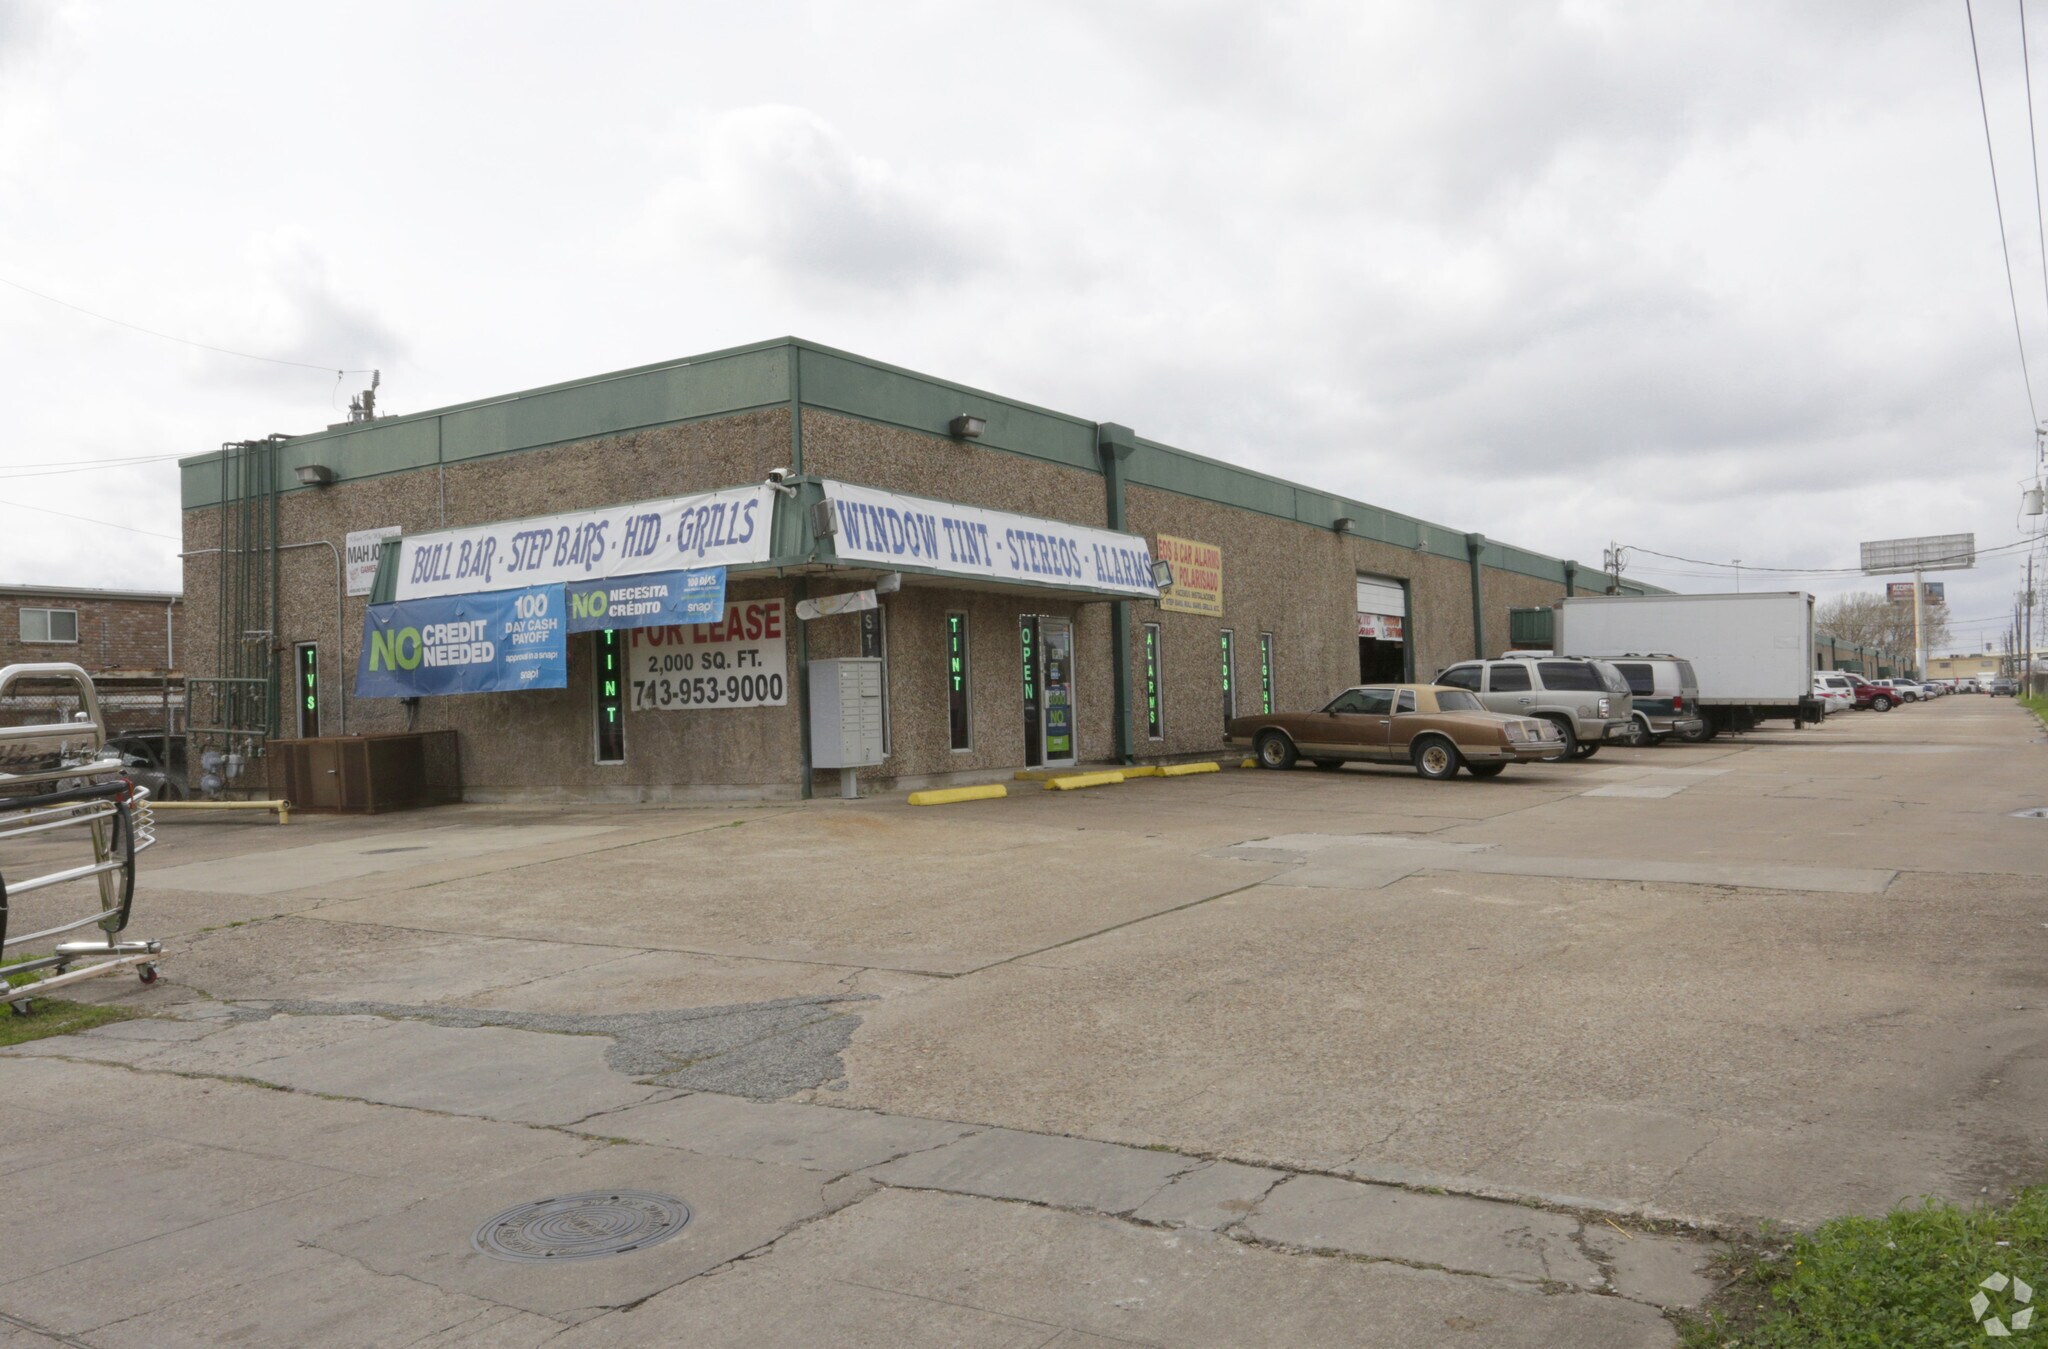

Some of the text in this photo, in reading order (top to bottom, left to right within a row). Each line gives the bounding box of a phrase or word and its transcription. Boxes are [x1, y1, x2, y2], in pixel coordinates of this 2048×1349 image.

[348, 543, 382, 564] MAH JO
[411, 498, 758, 584] BULL BAR STEP BARS HID GRILLS
[836, 500, 1155, 589] WINDOW TINT STEREOS ALARMS
[1180, 543, 1192, 565] CAR
[1194, 545, 1220, 570] ALARMS
[514, 593, 548, 619] 100
[572, 585, 669, 619] NO NECESITA
[608, 601, 661, 617] CRÉDITO
[505, 618, 557, 634] DAY CASH
[512, 630, 550, 645] PAYOFF
[632, 603, 782, 648] FOR LEASE
[1358, 615, 1371, 626] UTO
[1358, 626, 1376, 637] RMS
[369, 619, 487, 672] NO CREDIT
[423, 641, 495, 667] NEEDED
[648, 649, 763, 676] 2,000 SQ. FT.
[950, 618, 961, 691] TINT
[307, 650, 315, 710] TVS
[520, 668, 539, 680] snap!
[604, 629, 616, 723] TINT
[1022, 628, 1033, 699] OPEN
[1146, 633, 1155, 724] ALARMS
[1261, 640, 1269, 714] LIGTHS
[633, 673, 783, 707] 713-953-9000
